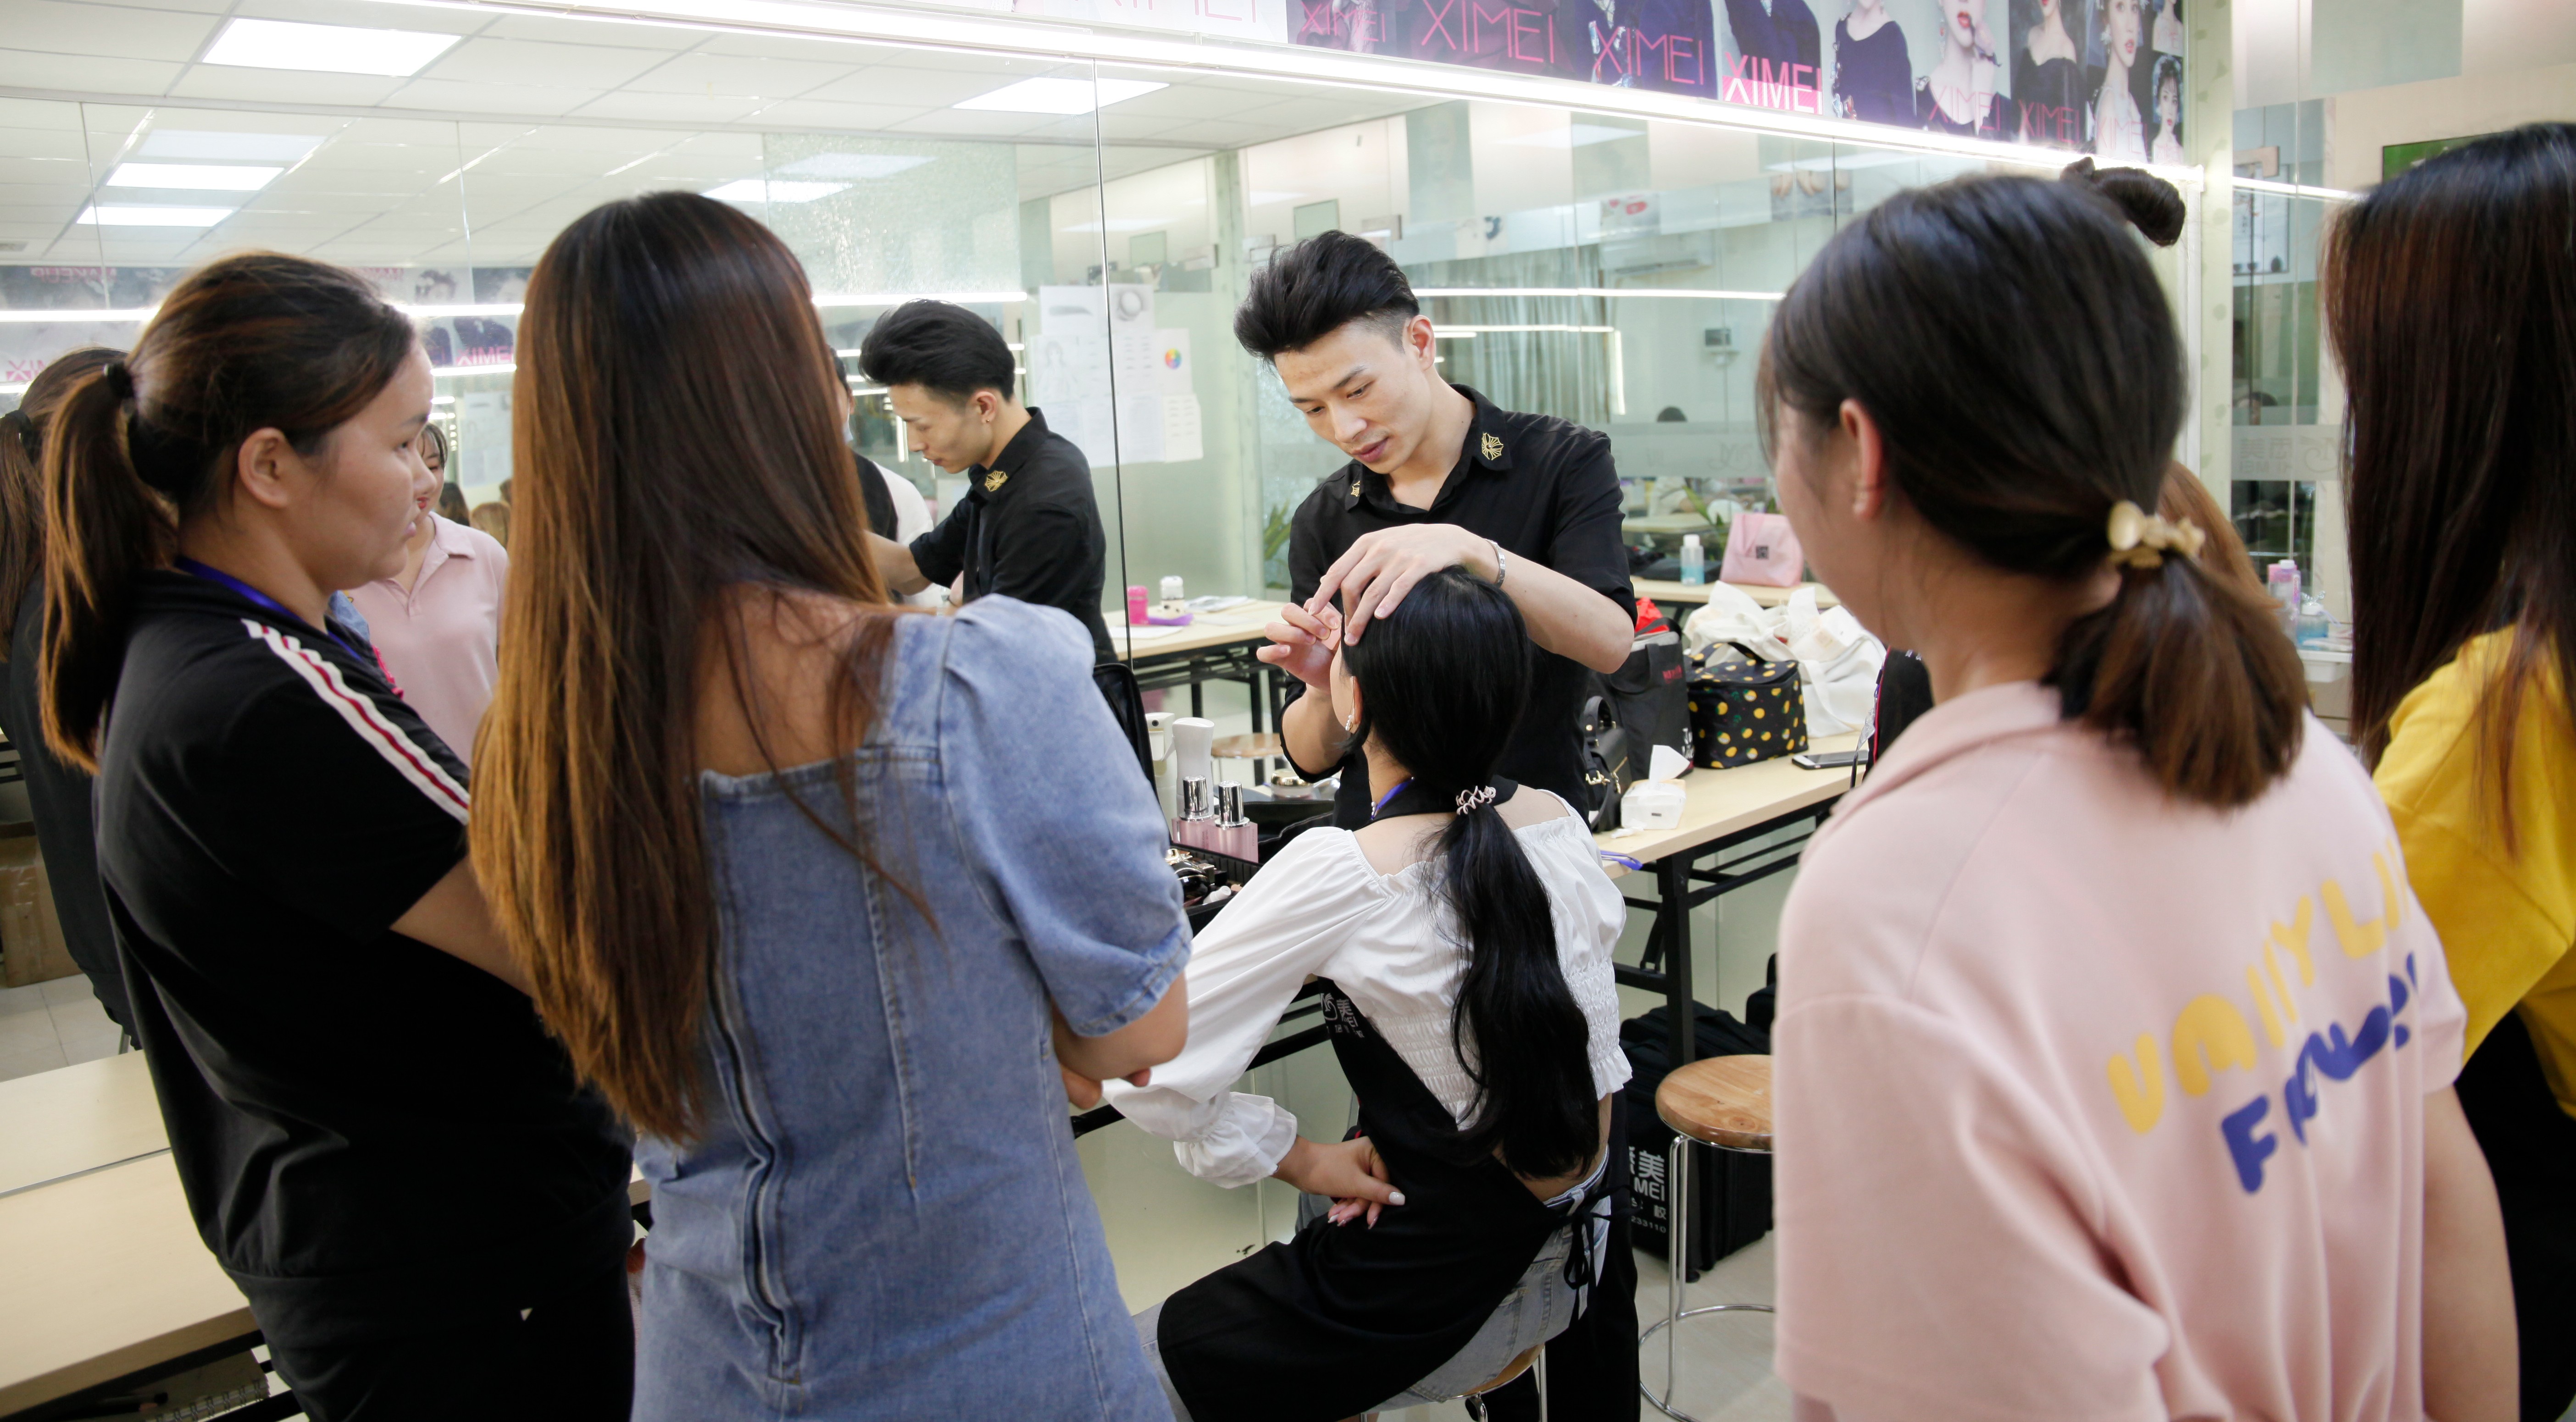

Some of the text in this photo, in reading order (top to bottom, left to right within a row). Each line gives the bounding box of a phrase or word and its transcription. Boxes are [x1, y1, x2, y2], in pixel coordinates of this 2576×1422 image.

[1300, 1, 1386, 43] XIMEI
[1421, 0, 1555, 63] XIMEI
[1592, 23, 1704, 86] XIMEI
[1722, 51, 1823, 116] XIMEI
[1928, 85, 2001, 132] XIMEI
[2018, 99, 2080, 144] XIMEI
[2095, 116, 2148, 155] XIMEI
